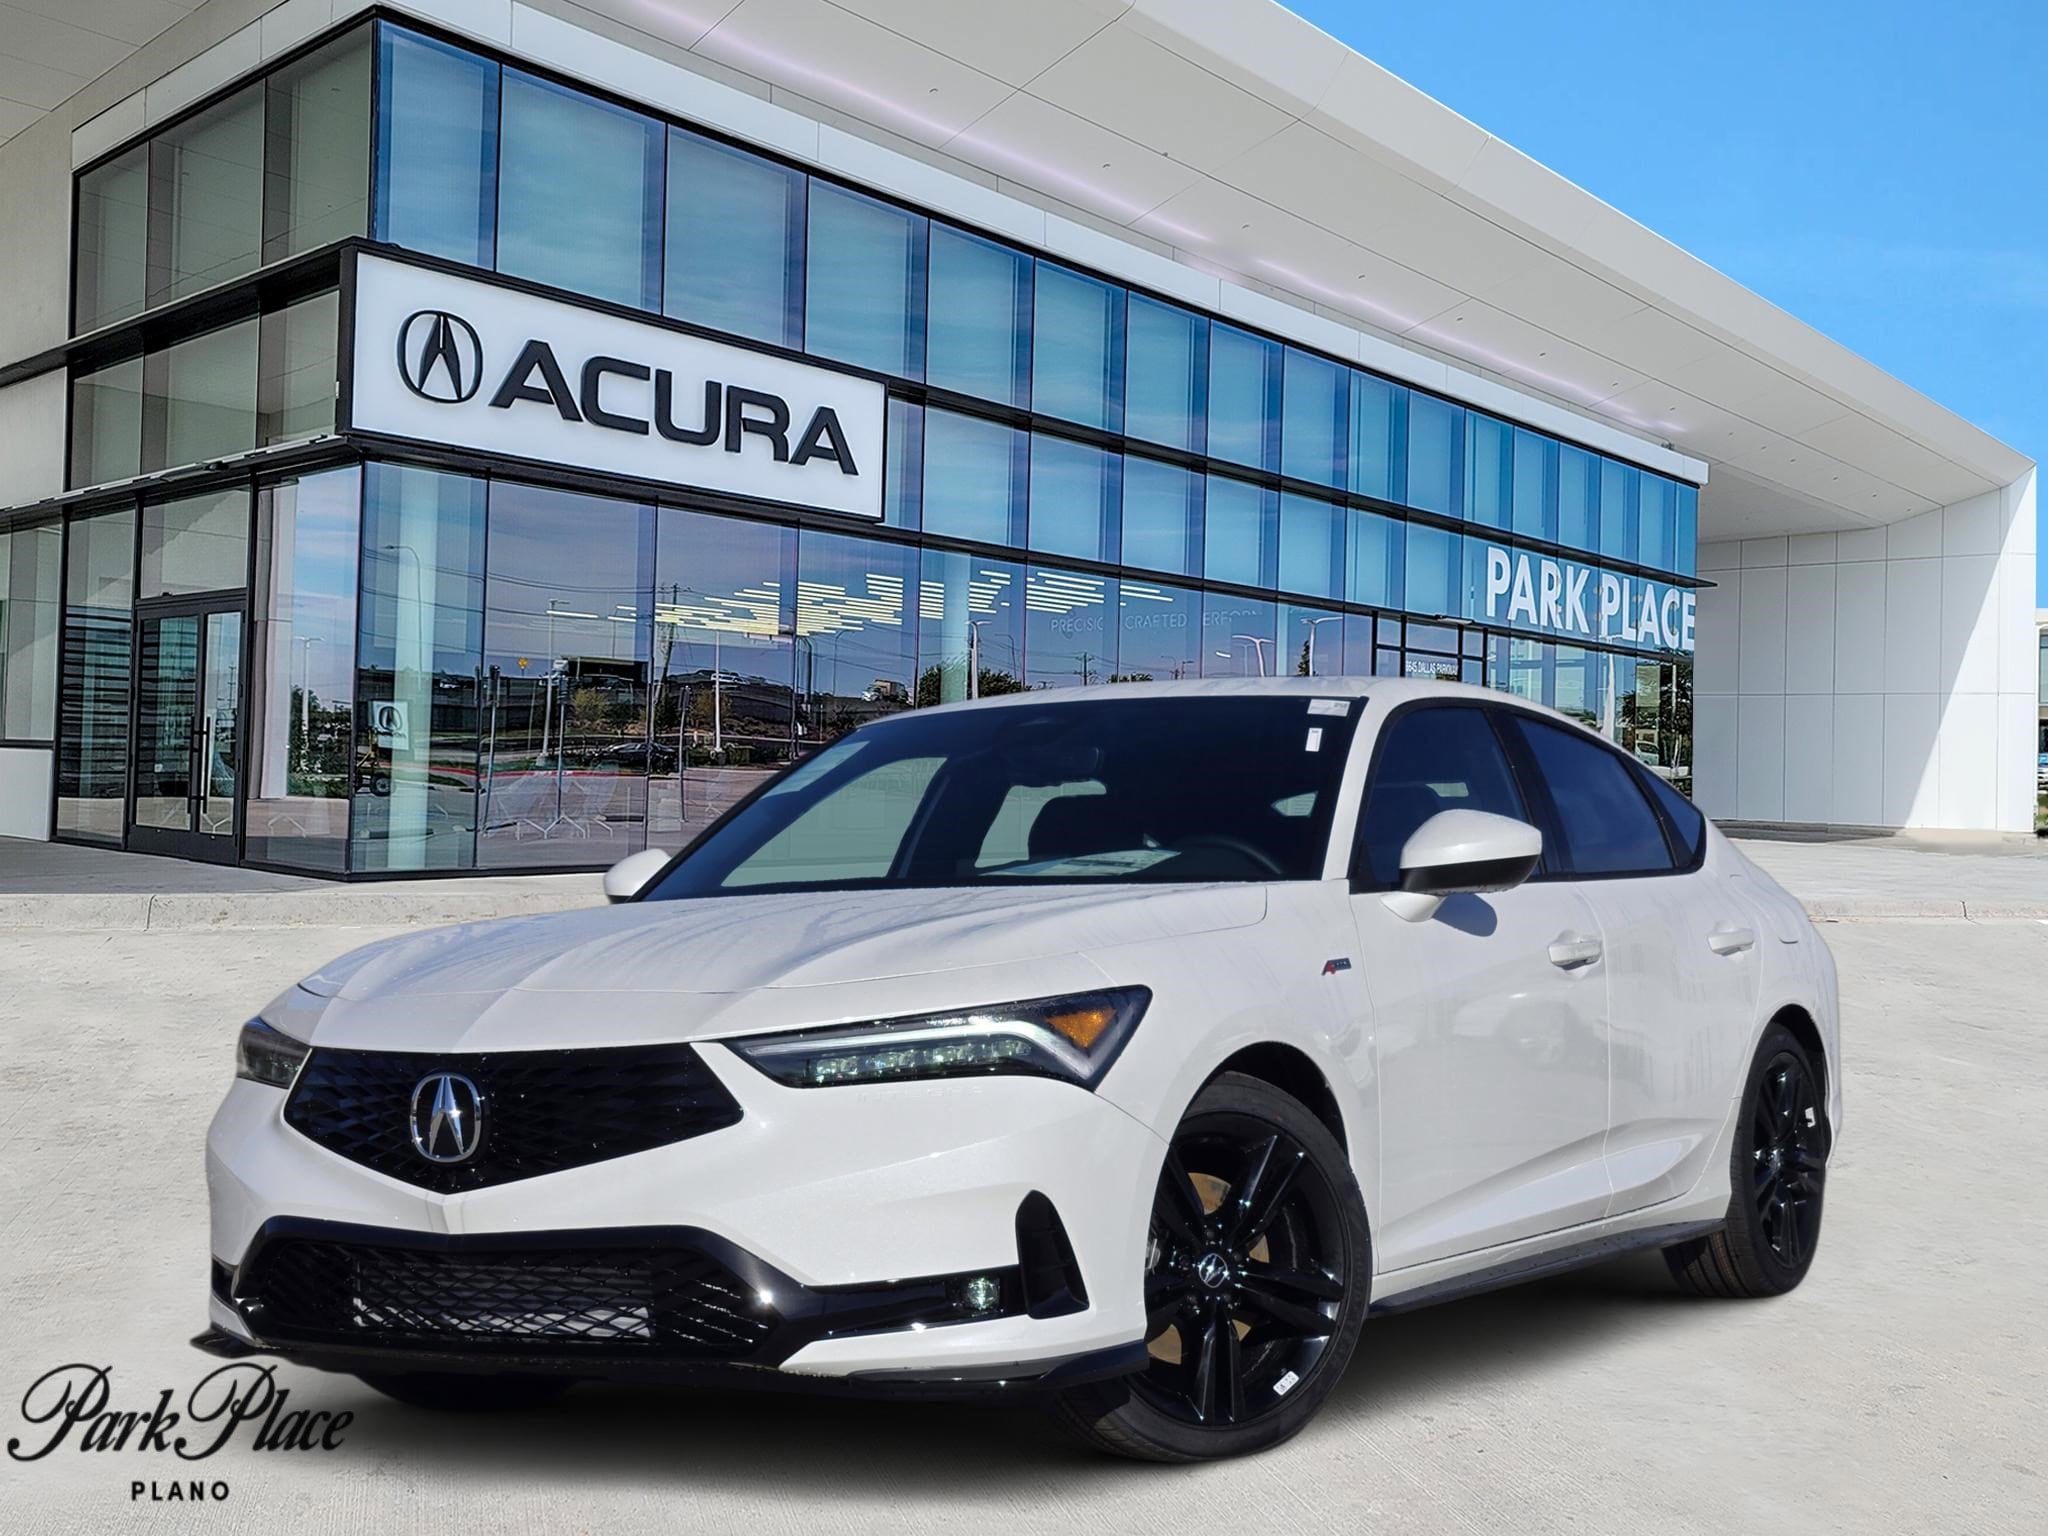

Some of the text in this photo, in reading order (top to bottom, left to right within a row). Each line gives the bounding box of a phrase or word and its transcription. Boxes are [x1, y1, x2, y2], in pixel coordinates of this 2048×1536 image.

[488, 339, 859, 476] ACURA
[1124, 612, 1188, 630] CRAFTED
[1486, 546, 1697, 650] PARK PLACE
